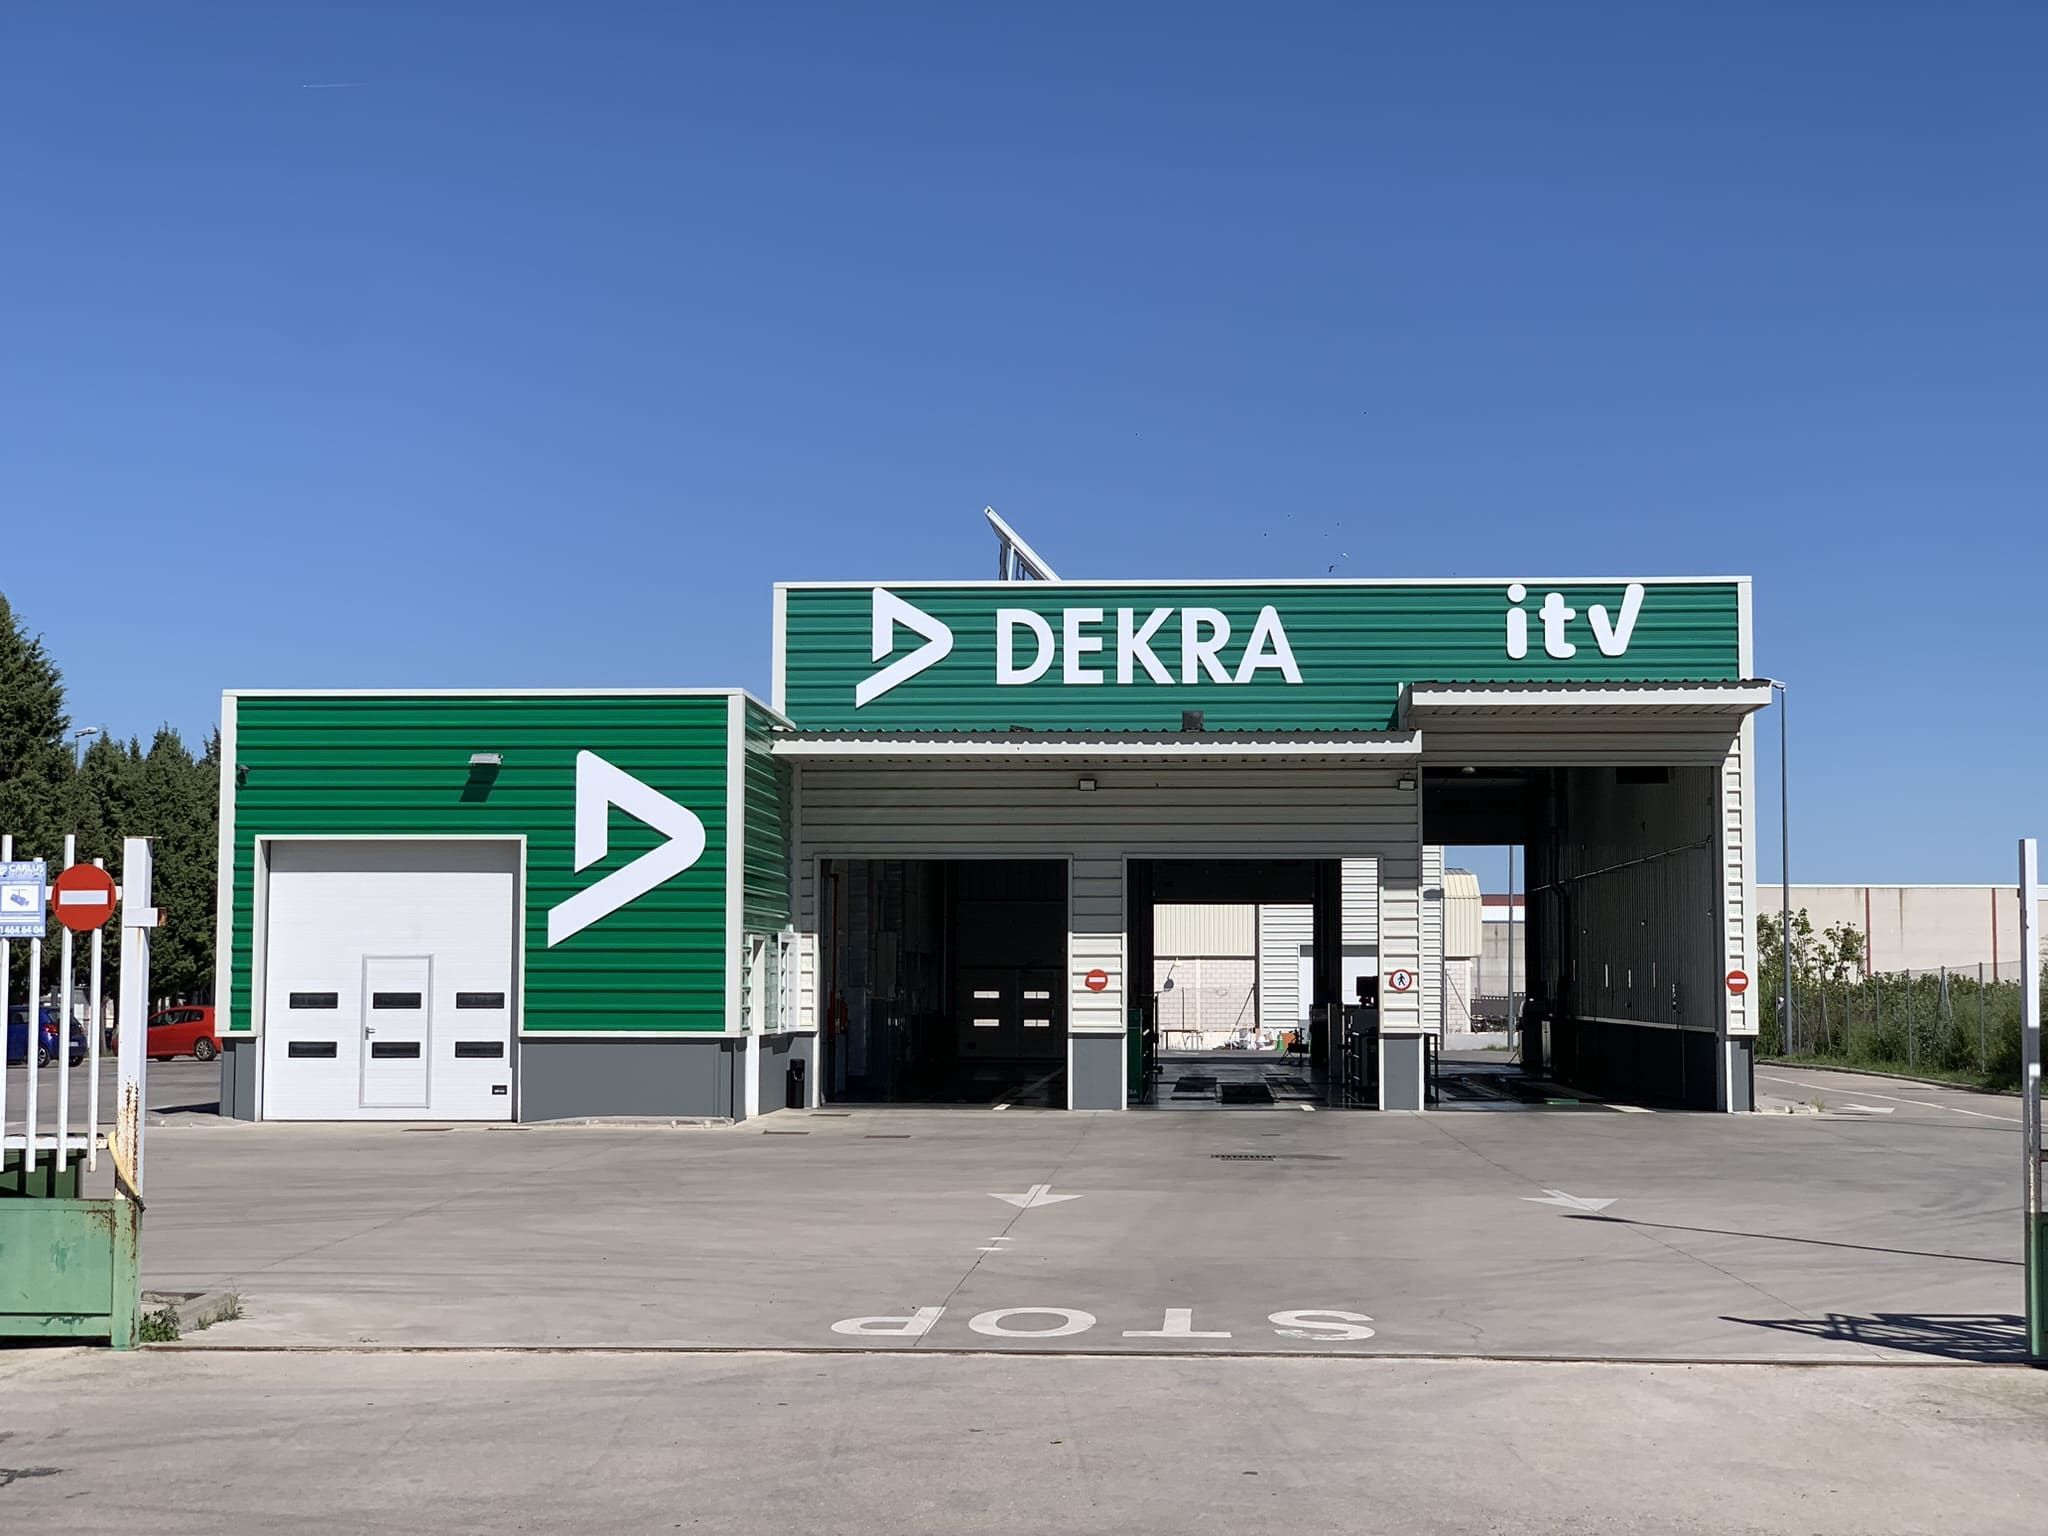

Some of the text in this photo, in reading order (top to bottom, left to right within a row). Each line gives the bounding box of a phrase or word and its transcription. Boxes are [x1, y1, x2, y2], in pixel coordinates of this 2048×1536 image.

[997, 605, 1303, 684] DEKRA
[1507, 583, 1645, 659] itv
[9, 864, 44, 872] CARLUS
[831, 1306, 1375, 1340] STOP
